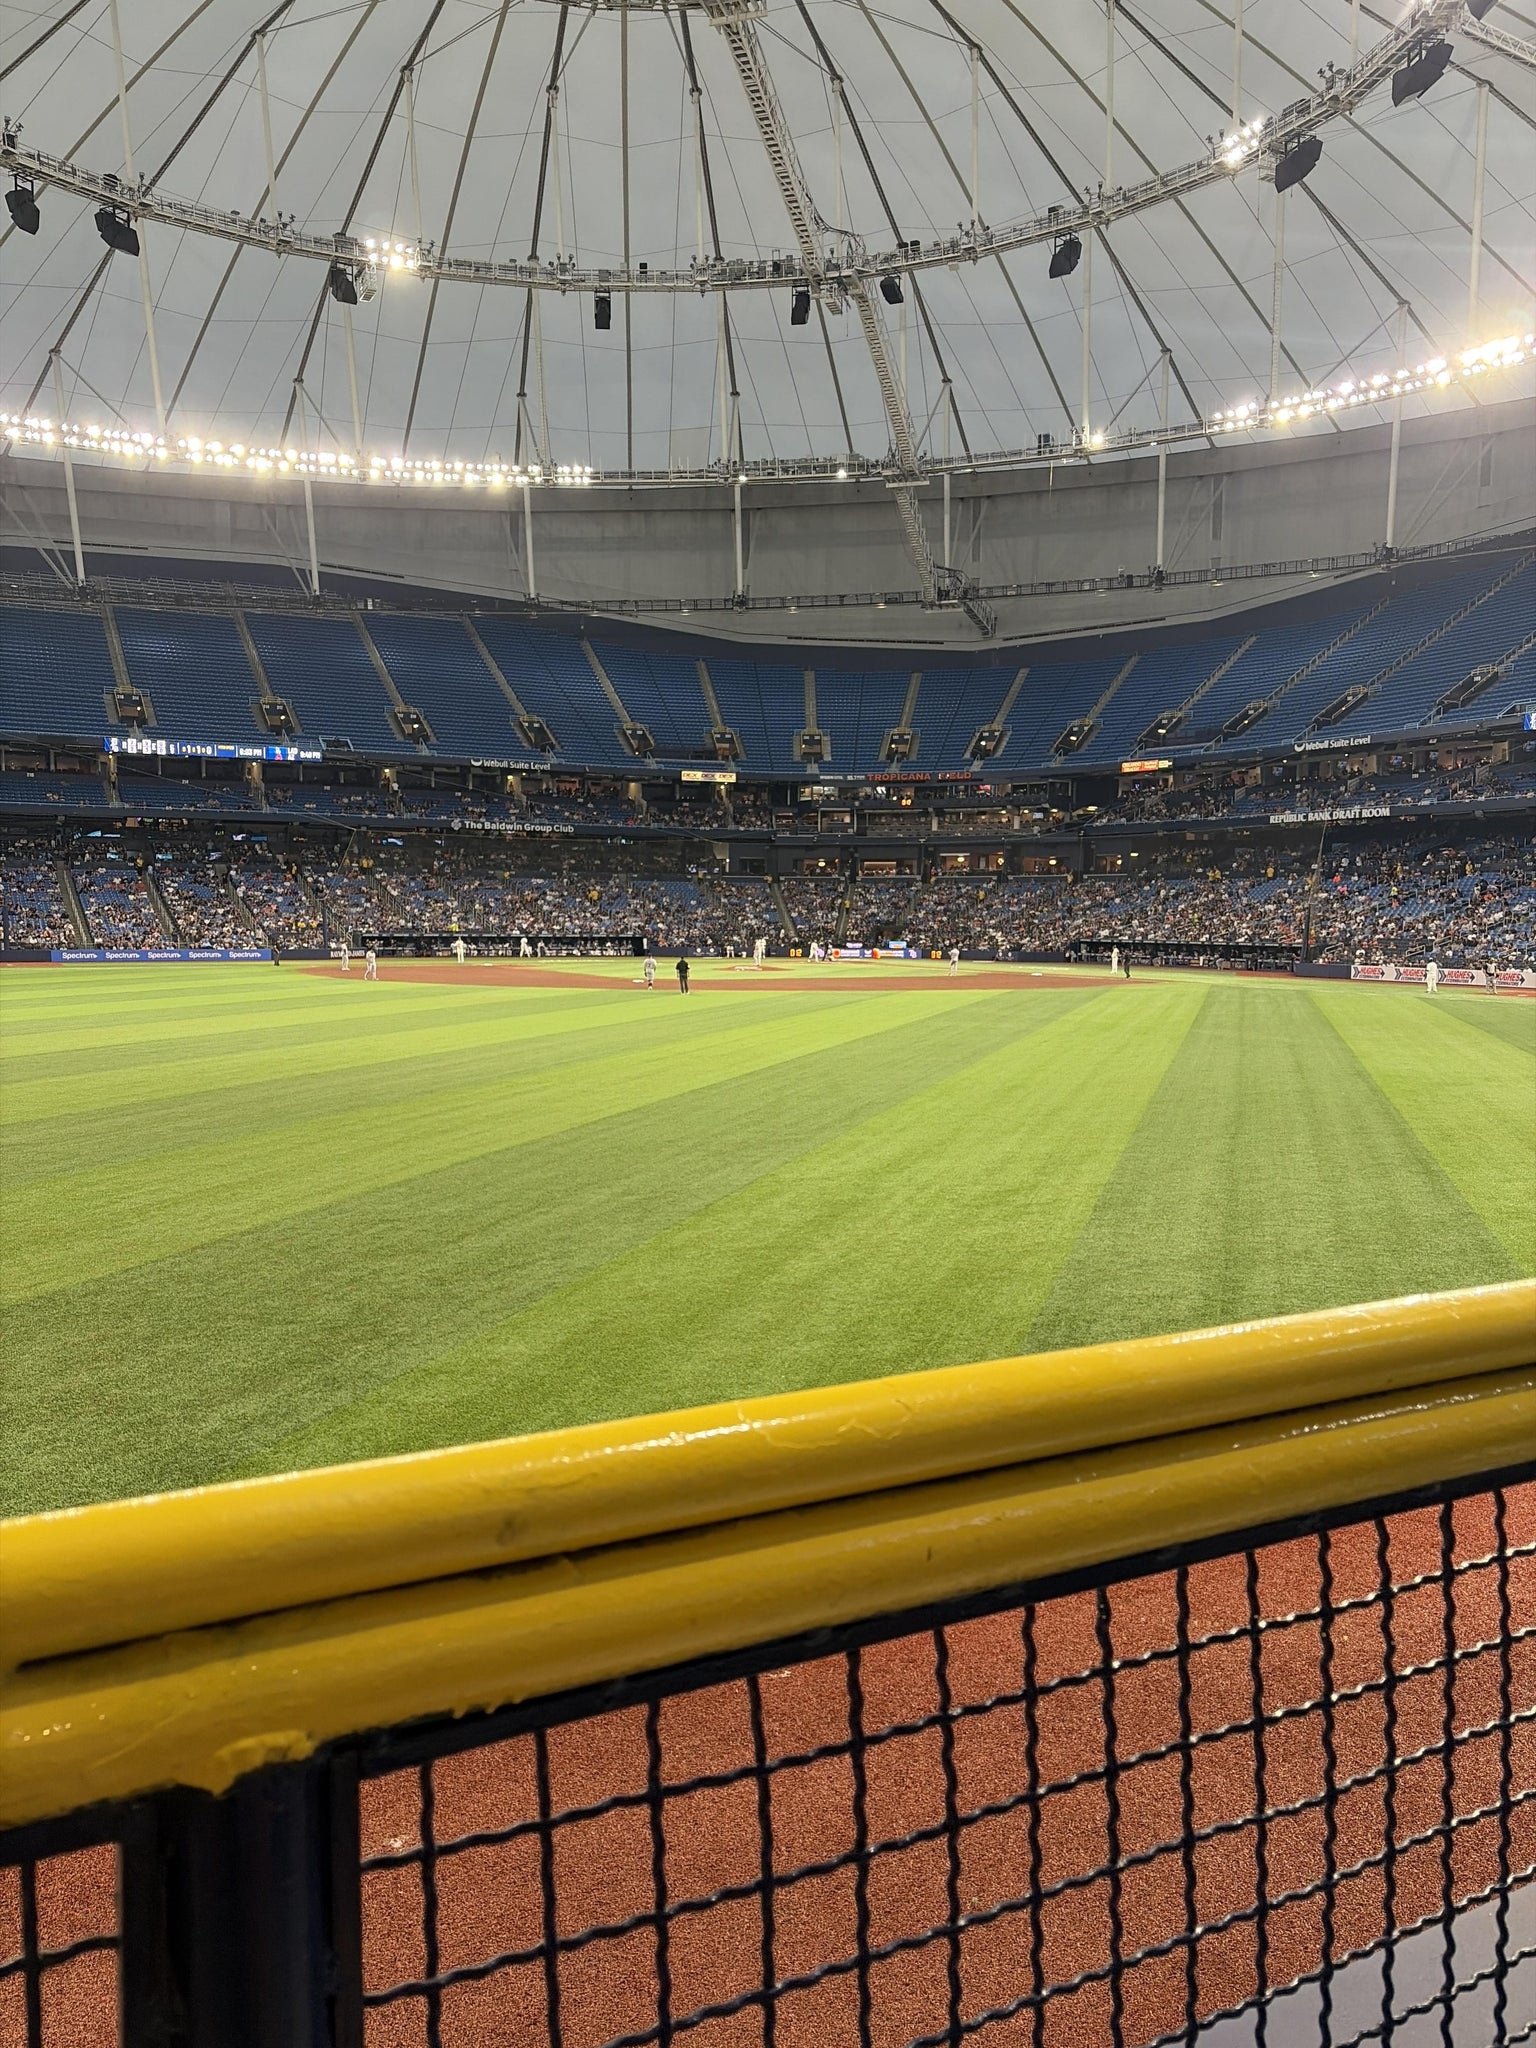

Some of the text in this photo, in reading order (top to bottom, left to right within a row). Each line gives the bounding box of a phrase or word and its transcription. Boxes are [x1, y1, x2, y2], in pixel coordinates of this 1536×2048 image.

[1330, 739, 1349, 748] Suite
[1350, 735, 1371, 746] Level
[484, 760, 550, 770] Webull Suite Level
[1270, 807, 1390, 823] REPUBLIC BANK DRAFT ROOM
[464, 821, 574, 832] The Baldwin Group Club
[62, 952, 95, 960] Spectrum
[1360, 966, 1380, 975] HUGHES
[1402, 968, 1424, 976] HUGHES
[1447, 970, 1470, 978] HUGHES
